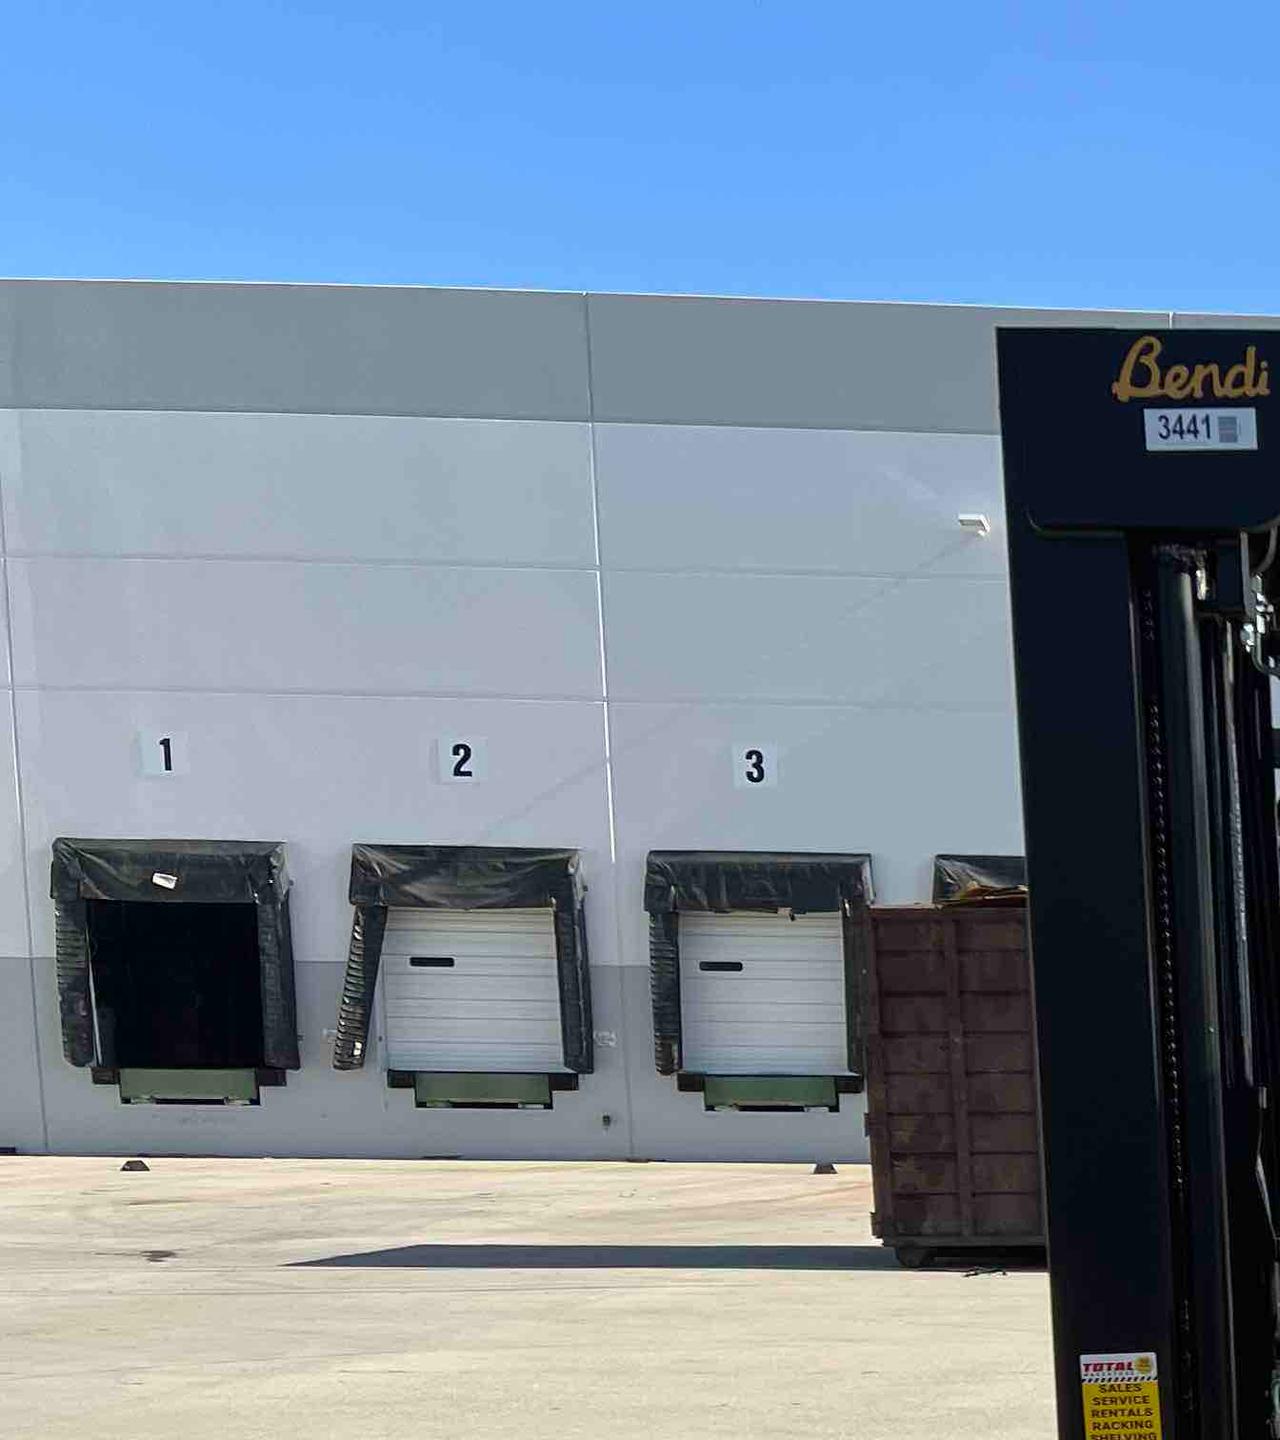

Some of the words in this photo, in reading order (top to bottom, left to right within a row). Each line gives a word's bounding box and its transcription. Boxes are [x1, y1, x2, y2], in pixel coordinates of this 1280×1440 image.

[1112, 335, 1271, 402] Bendi
[1158, 414, 1211, 440] 3441
[159, 737, 173, 772] 1
[452, 743, 473, 778] 2
[745, 749, 765, 784] 3
[1083, 1361, 1133, 1372] TOTAL
[1098, 1383, 1142, 1393] SALES
[1092, 1395, 1150, 1406] SERVICE
[1091, 1408, 1153, 1418] RENTALS
[1092, 1420, 1153, 1431] RACKING
